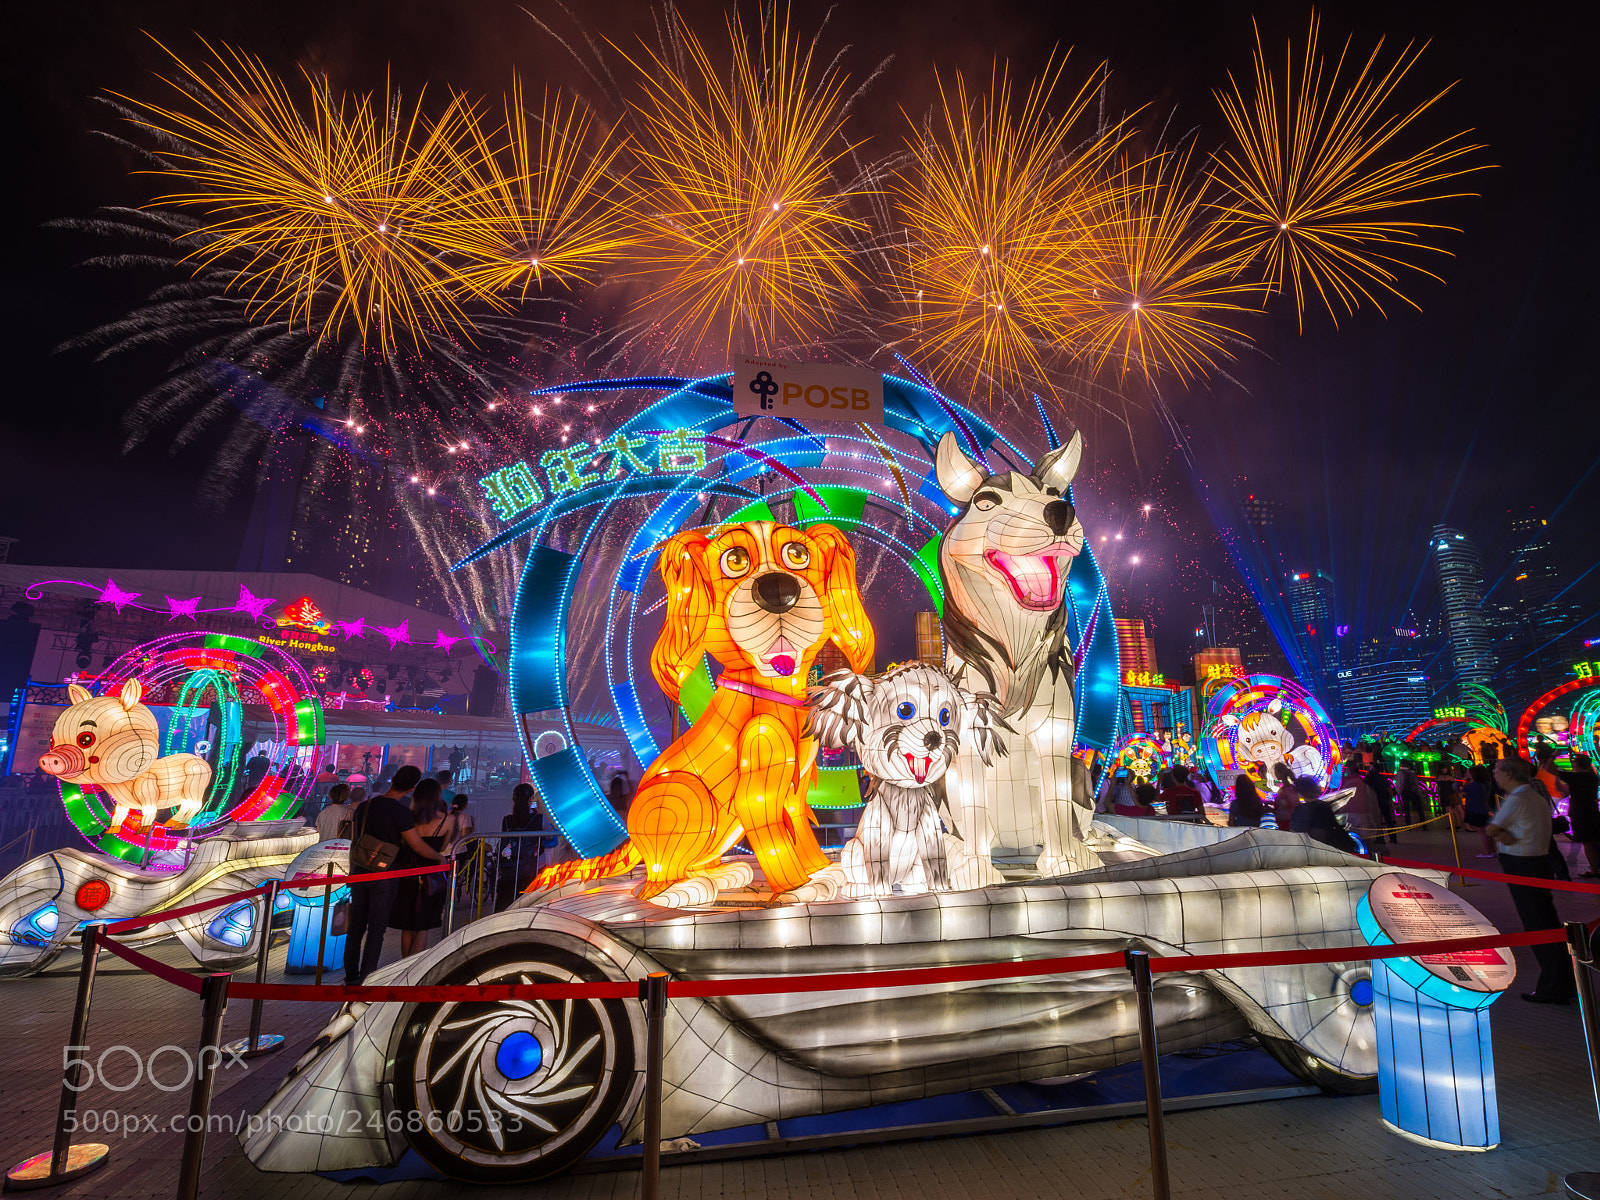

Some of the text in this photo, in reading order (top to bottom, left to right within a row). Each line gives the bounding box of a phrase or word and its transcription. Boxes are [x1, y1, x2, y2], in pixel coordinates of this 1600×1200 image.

[744, 359, 776, 368] Adopted
[782, 382, 871, 411] POSB
[478, 427, 707, 522] 狗年大吉
[258, 635, 336, 653] River Hongbao
[1337, 670, 1353, 679] OUE
[81, 886, 103, 904] 猪
